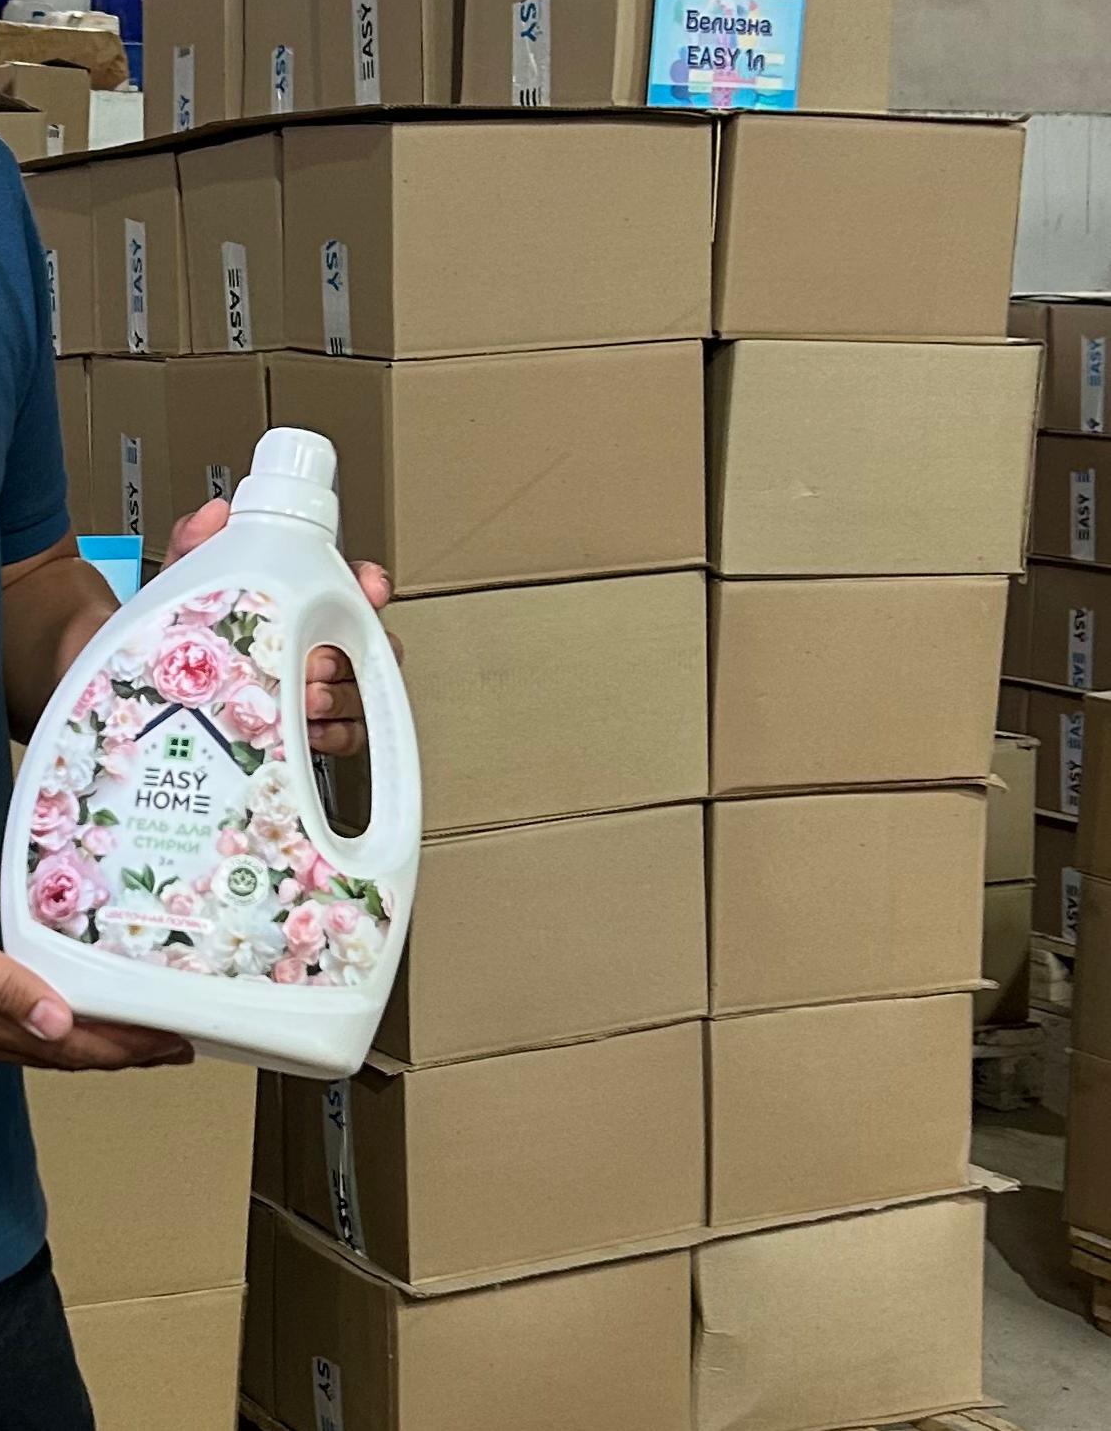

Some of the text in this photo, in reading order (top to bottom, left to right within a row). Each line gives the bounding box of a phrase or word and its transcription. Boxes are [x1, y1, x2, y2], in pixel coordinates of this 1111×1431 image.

[686, 10, 773, 36] Белизна
[359, 3, 375, 81] EASY
[687, 45, 766, 71] EASY 1л
[179, 95, 191, 131] SY
[131, 238, 143, 313] EASY
[228, 268, 246, 349] EASY
[1077, 494, 1090, 540] EASY
[143, 767, 208, 791] EASY
[135, 789, 211, 814] HOME
[127, 817, 212, 837] ГЕЛЬ ДЛЯ
[134, 835, 201, 855] СТИРКИ
[329, 1080, 345, 1130] SY
